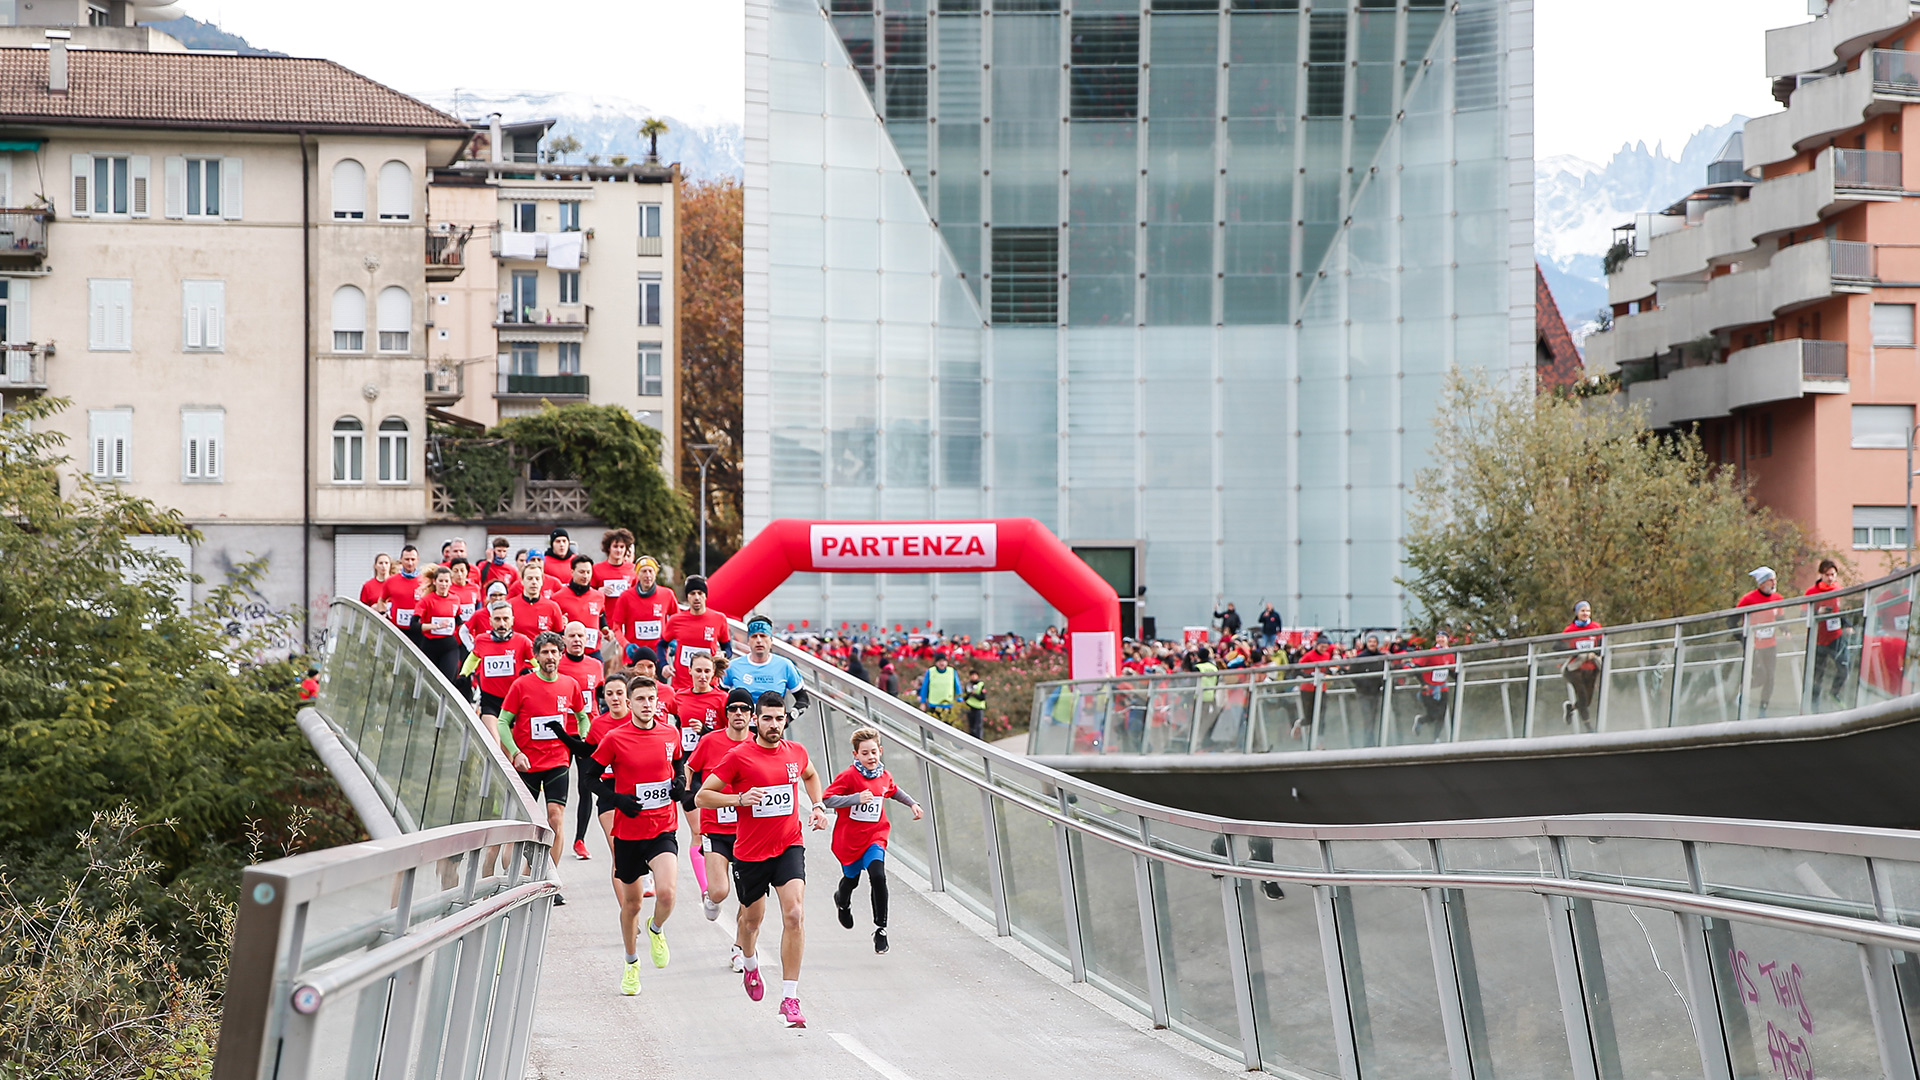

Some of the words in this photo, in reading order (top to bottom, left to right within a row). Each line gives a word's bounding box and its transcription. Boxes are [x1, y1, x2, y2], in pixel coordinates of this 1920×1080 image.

[821, 536, 985, 556] PARTENZA
[638, 625, 660, 633] 1244
[487, 661, 510, 669] 1071
[643, 788, 667, 801] 988
[1729, 948, 1759, 1006] IS
[1758, 960, 1813, 1035] THIS
